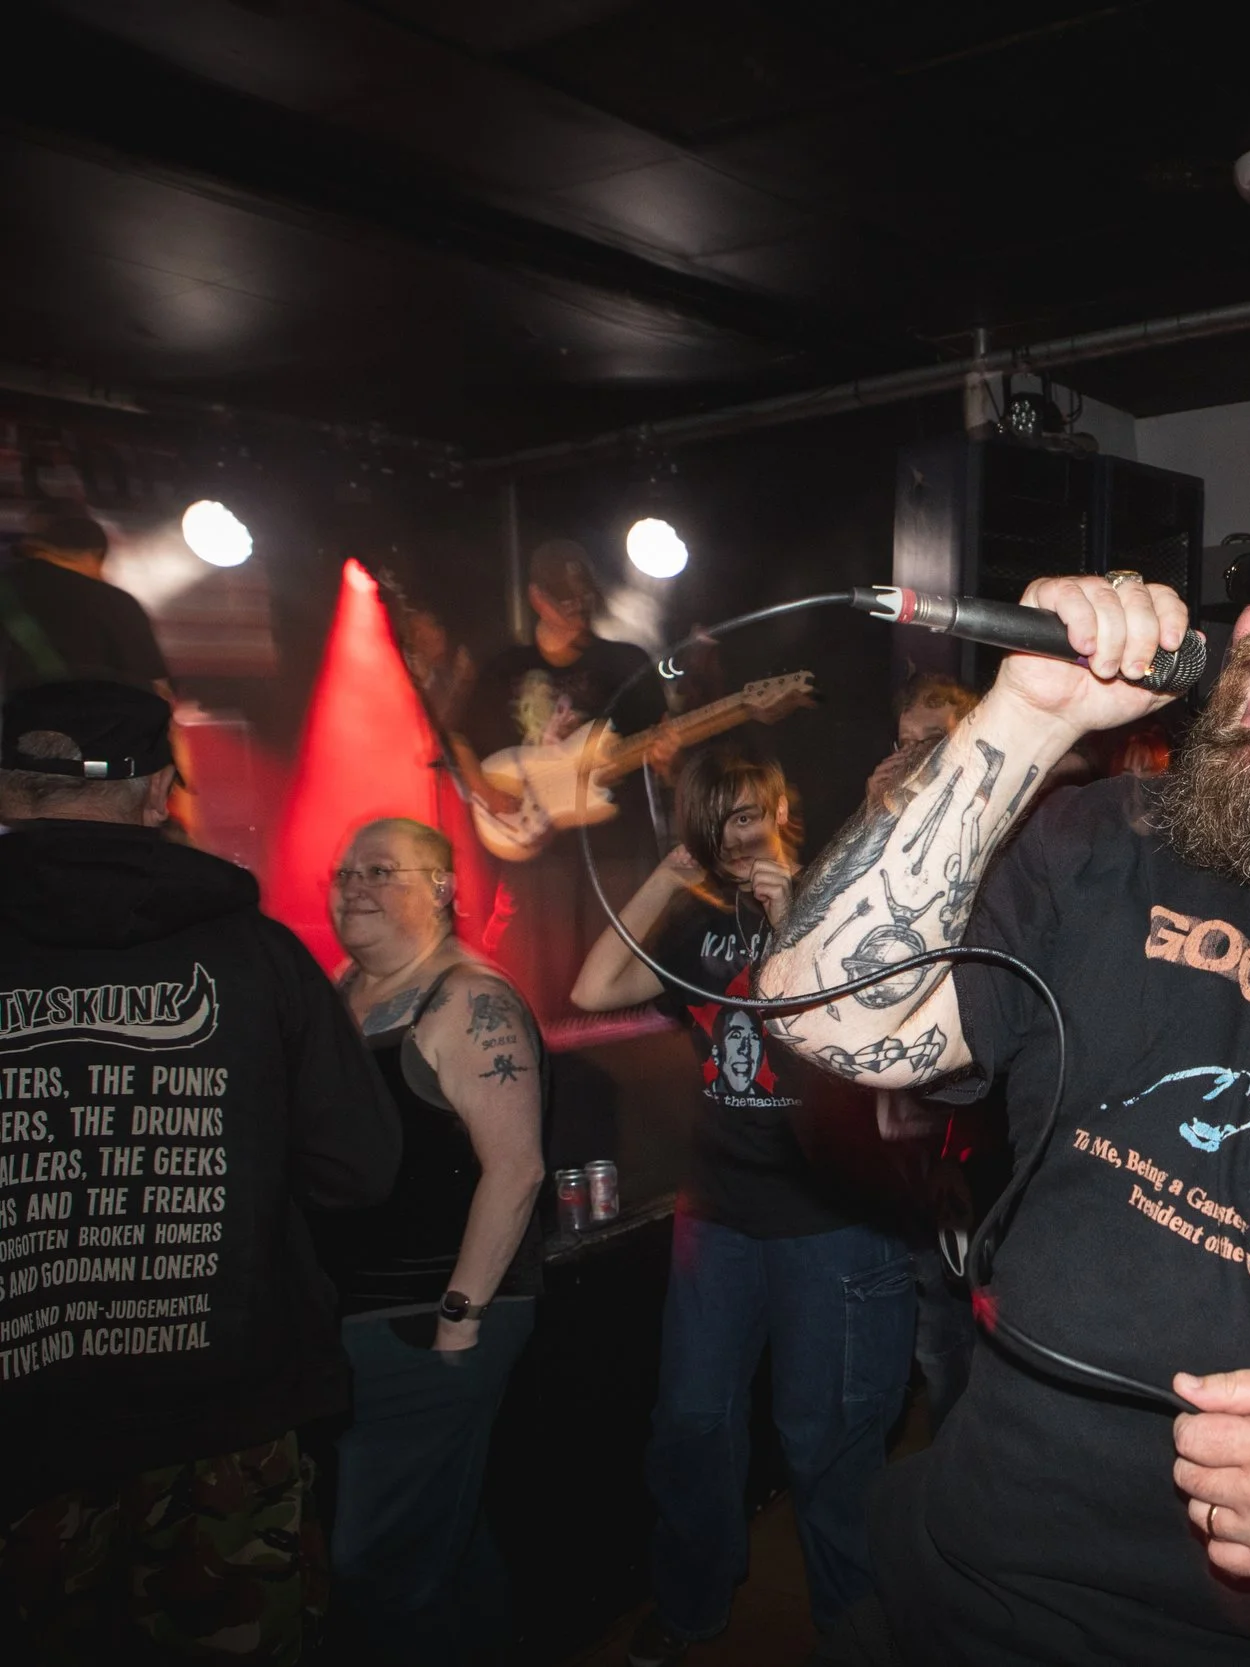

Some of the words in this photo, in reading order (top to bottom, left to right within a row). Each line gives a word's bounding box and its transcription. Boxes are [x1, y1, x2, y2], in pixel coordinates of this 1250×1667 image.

[47, 982, 183, 1026] SKUNK
[0, 1066, 70, 1099] TERS,
[88, 1065, 136, 1095] THE
[152, 1065, 229, 1096] PUNKS
[70, 1106, 116, 1137] THE
[131, 1106, 224, 1137] DRUNKS
[0, 1149, 88, 1189] ALLERS,
[99, 1147, 146, 1176] THE
[153, 1147, 228, 1177] GEEKS
[1072, 1128, 1091, 1151] To
[1089, 1136, 1123, 1168] Me,
[1125, 1149, 1169, 1191] Being
[1168, 1178, 1184, 1196] a
[26, 1191, 73, 1222] AND
[87, 1188, 129, 1216] THE
[142, 1186, 226, 1214] FREAKS
[1128, 1184, 1205, 1245] President
[0, 1229, 69, 1262] ORGOTTEN
[78, 1224, 146, 1247] BROKEN
[155, 1222, 223, 1244] HOMERS
[10, 1266, 39, 1299] AND
[41, 1257, 136, 1288] GODDAMN
[141, 1253, 219, 1281] LONERS
[1, 1315, 35, 1342] HOME
[36, 1306, 60, 1331] AND
[65, 1293, 211, 1322] NON-JUDGEMENTAL
[0, 1342, 40, 1380] TIVE
[41, 1331, 74, 1366] AND
[82, 1321, 211, 1356] ACCIDENTAL
